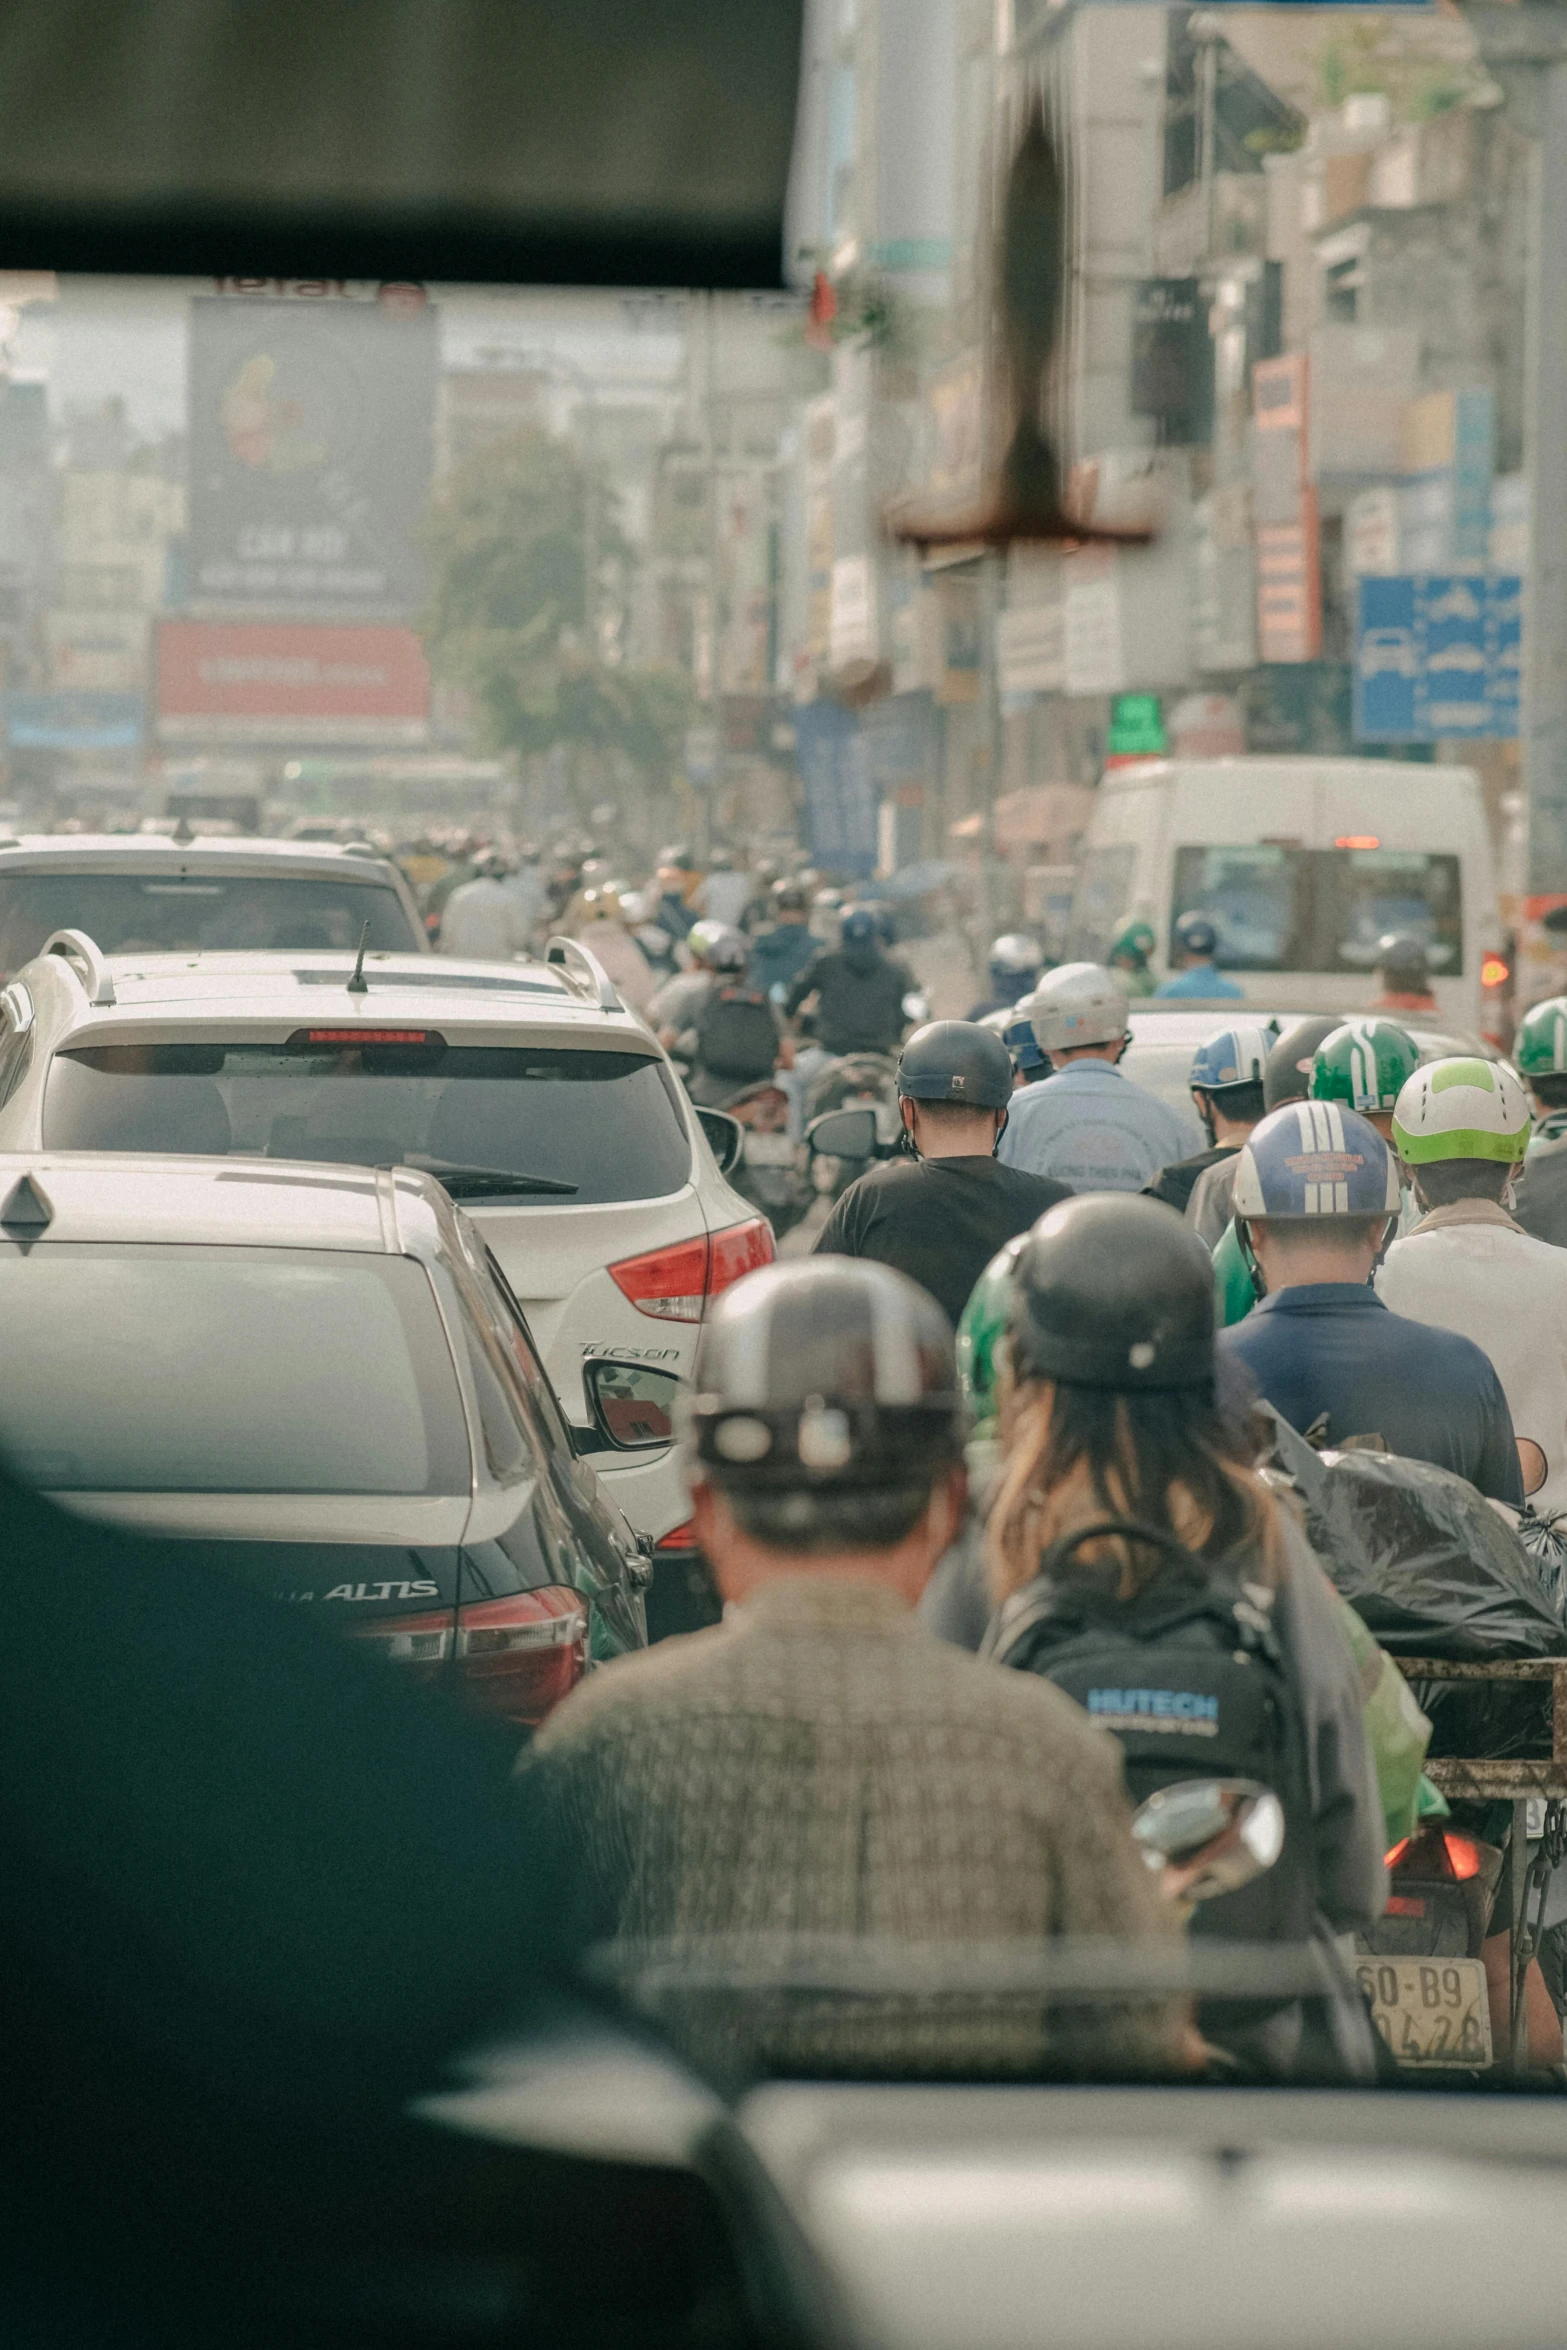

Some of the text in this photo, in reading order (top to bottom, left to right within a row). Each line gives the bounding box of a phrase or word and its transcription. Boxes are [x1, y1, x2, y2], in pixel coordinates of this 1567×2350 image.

[578, 1340, 680, 1360] Tucson
[323, 1579, 440, 1602] ALTIS
[1088, 1688, 1219, 1720] HUTECH
[1356, 1965, 1462, 2009] 60-B9
